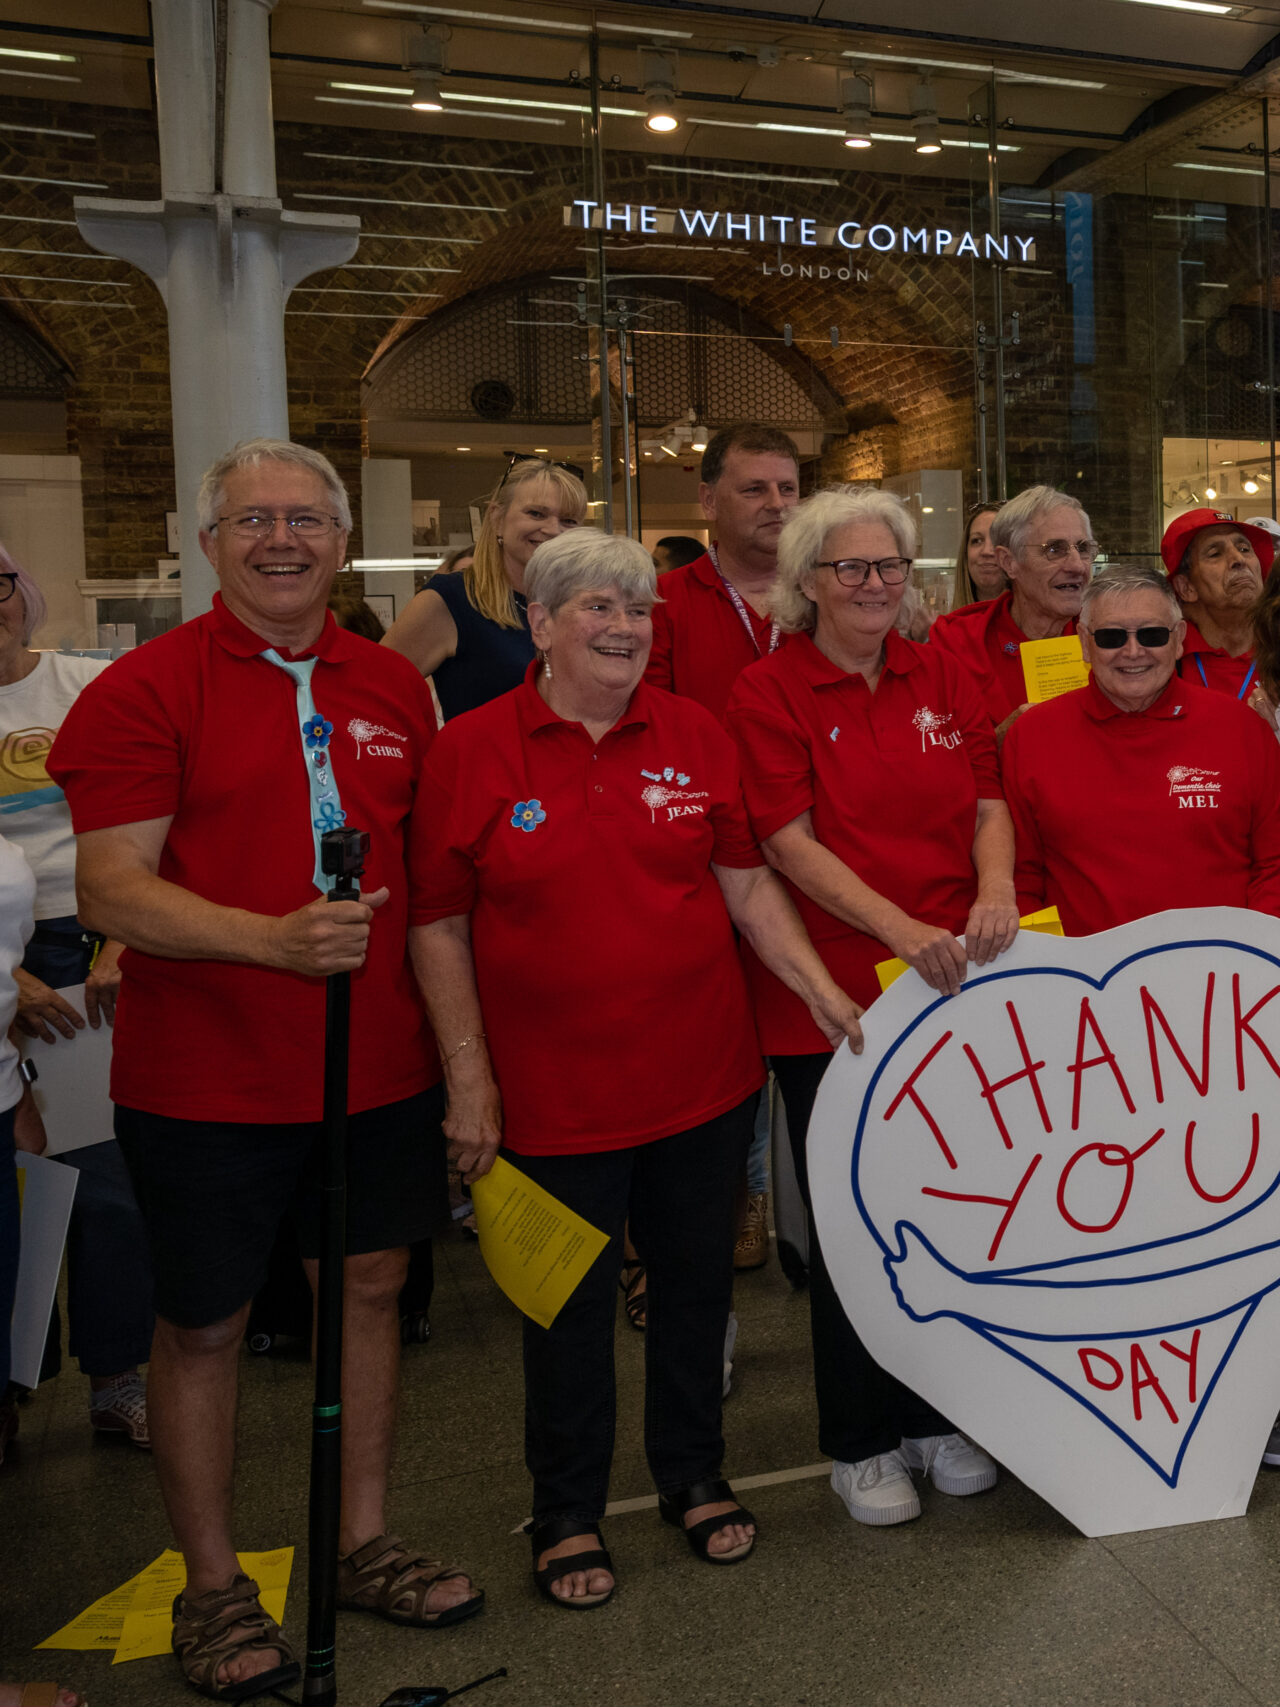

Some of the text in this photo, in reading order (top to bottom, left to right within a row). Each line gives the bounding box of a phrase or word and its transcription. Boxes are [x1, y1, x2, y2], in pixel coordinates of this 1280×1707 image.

[573, 200, 657, 233] THE
[678, 208, 817, 246] WHITE
[837, 222, 1035, 262] COMPANY
[763, 262, 870, 282] LONDON
[366, 745, 403, 758] CHRIS
[1178, 795, 1219, 809] MEL
[667, 804, 704, 821] JEAN
[921, 1113, 1260, 1262] YOU
[1077, 1328, 1202, 1425] DAY
